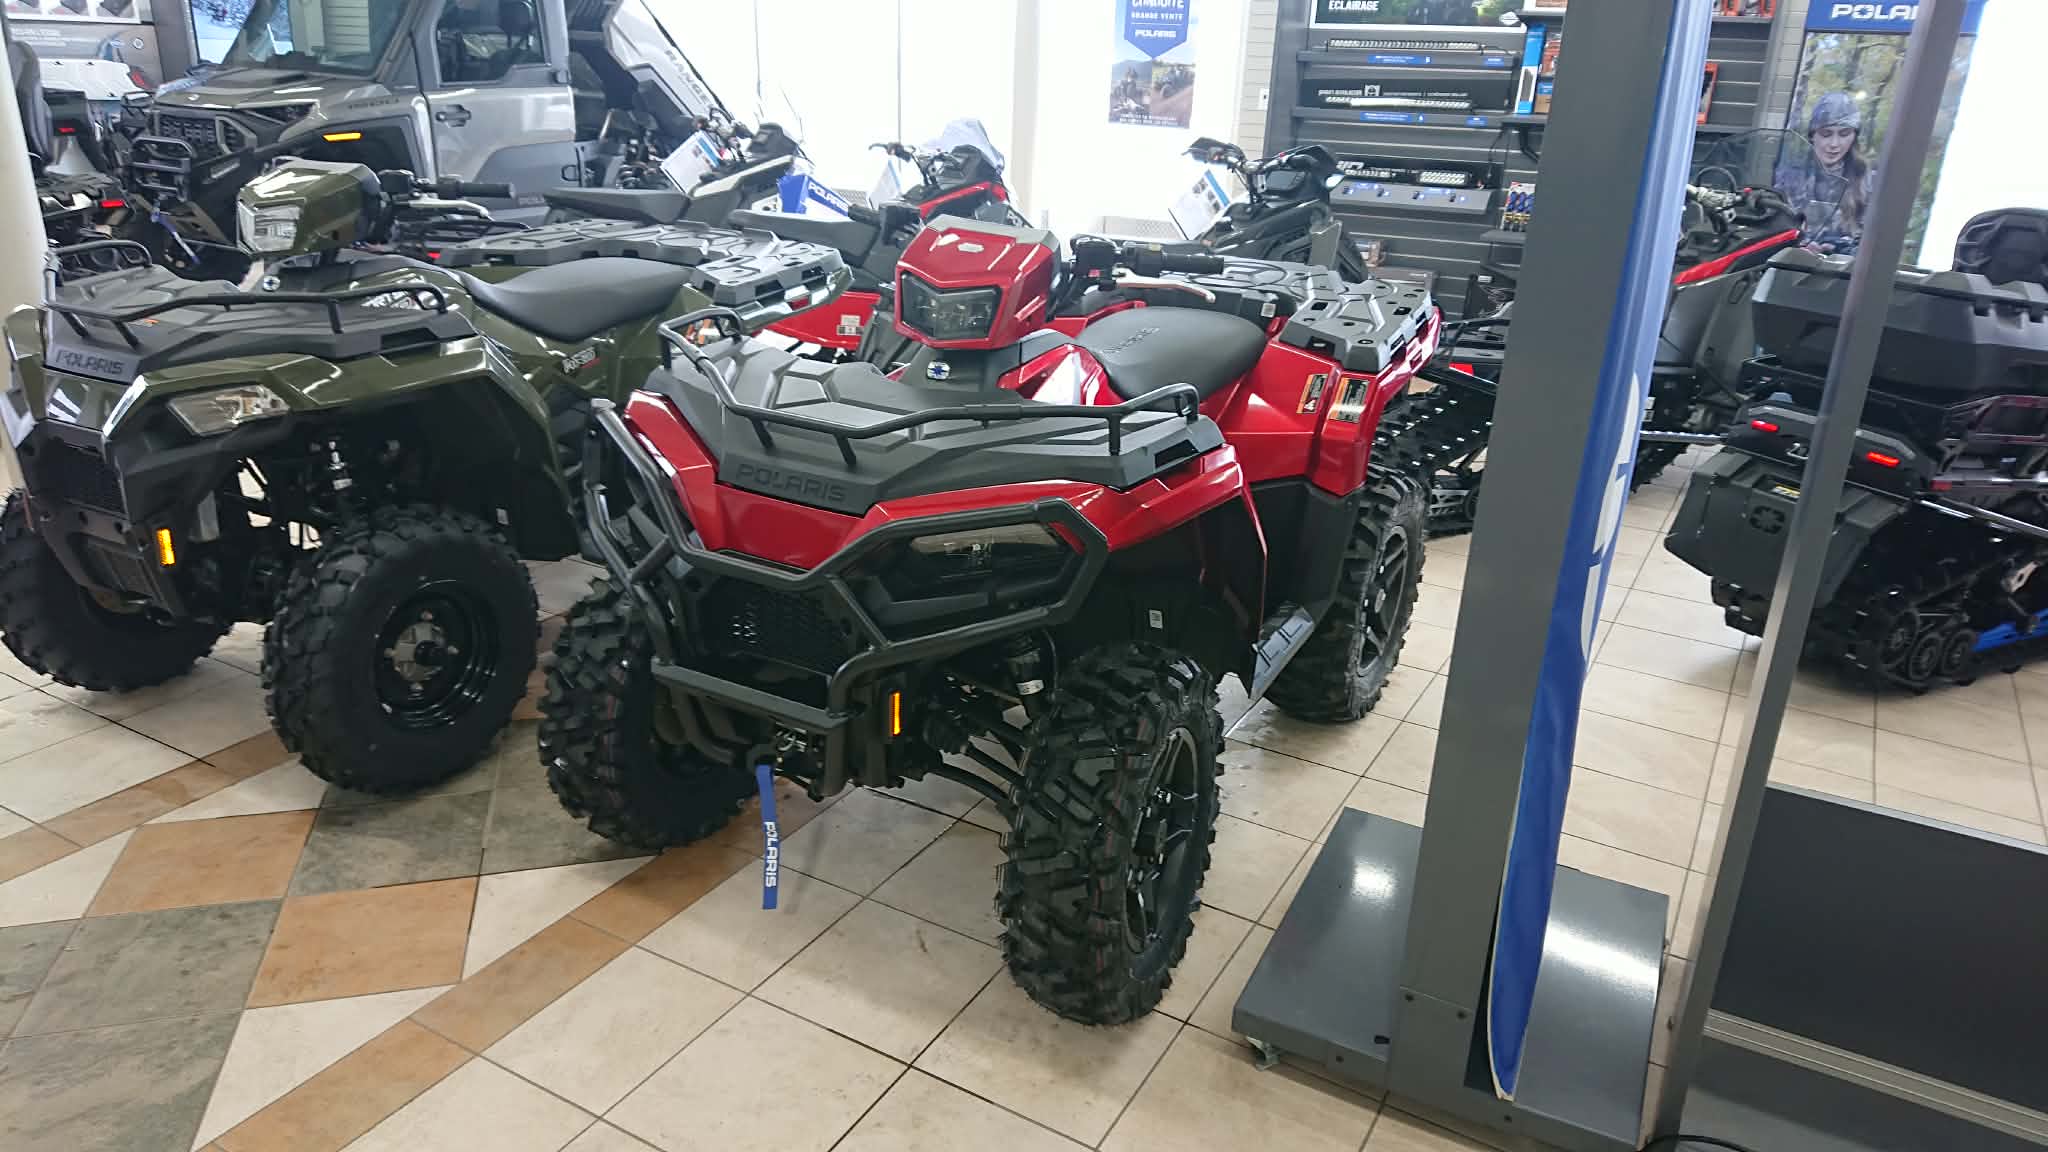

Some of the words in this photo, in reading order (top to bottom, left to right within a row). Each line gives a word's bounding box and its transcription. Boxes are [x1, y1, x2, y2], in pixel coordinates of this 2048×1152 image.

[1135, 29, 1177, 38] POLARIS
[55, 349, 126, 374] POLARIS
[736, 463, 846, 500] POLARIS
[764, 821, 778, 888] POLARIS
